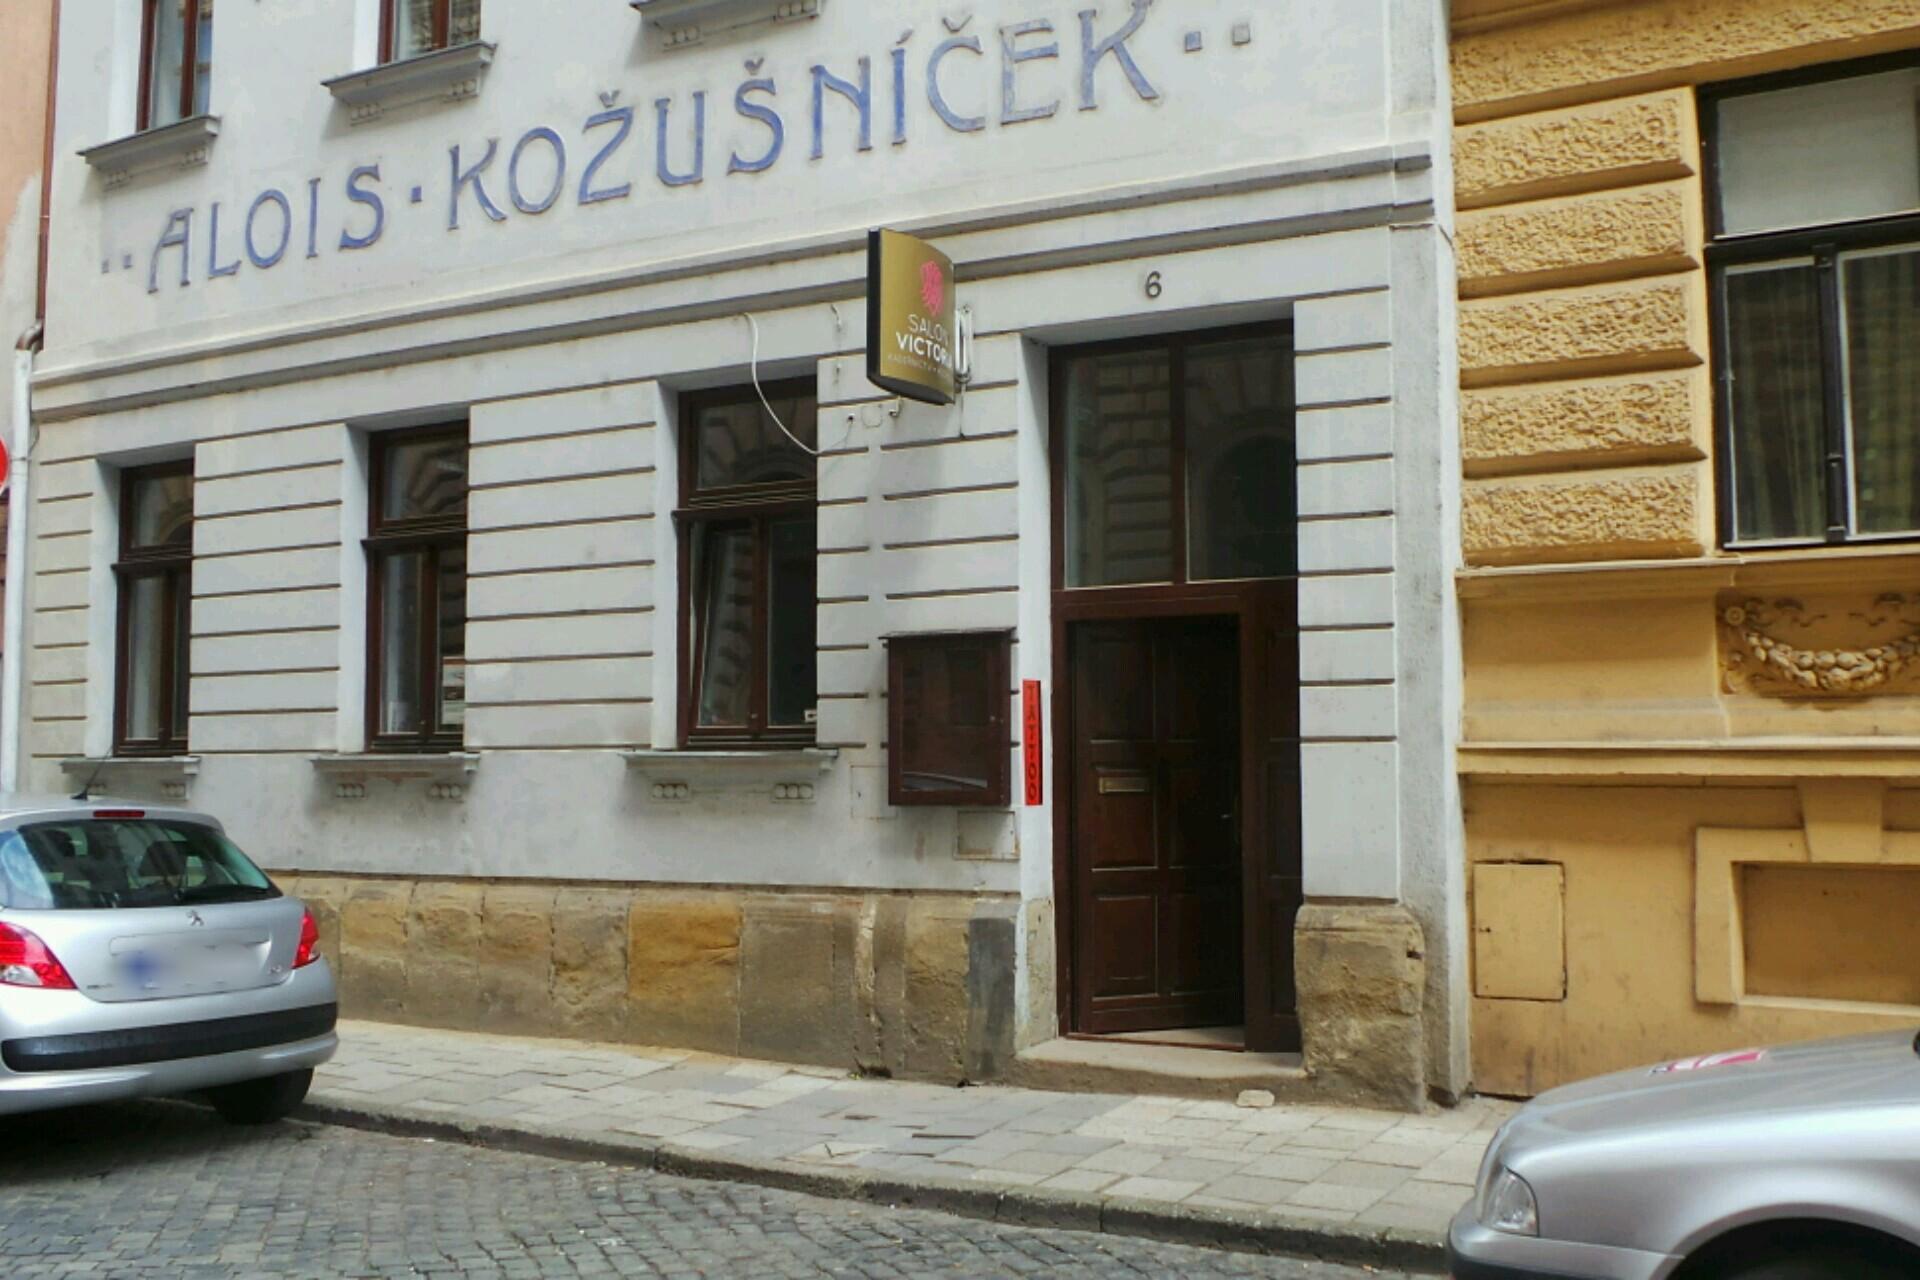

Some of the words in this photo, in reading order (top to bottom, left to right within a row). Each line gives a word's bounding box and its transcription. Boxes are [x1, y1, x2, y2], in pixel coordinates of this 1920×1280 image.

[148, 163, 384, 294] ALOIS
[447, 0, 1159, 231] KOŽUŠNÍČEK
[1144, 270, 1163, 299] 6
[1027, 684, 1038, 801] TATTOO
